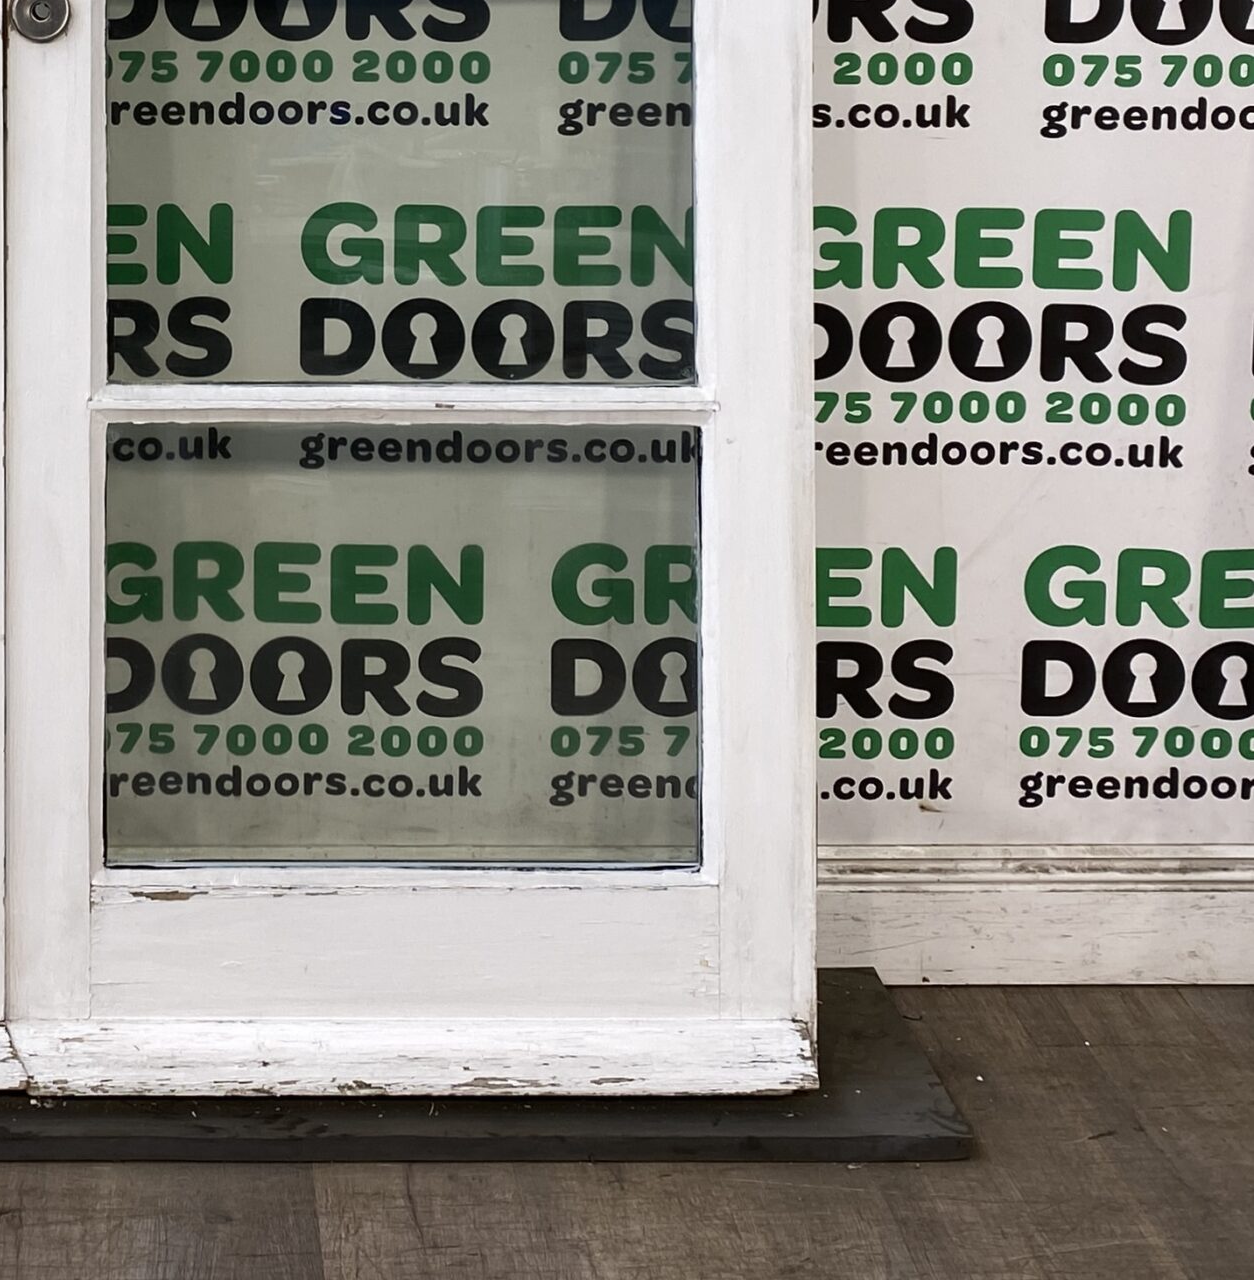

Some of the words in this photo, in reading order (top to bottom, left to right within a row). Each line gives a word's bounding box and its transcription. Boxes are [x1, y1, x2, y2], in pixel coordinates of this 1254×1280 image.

[108, 51, 178, 83] 75
[197, 50, 333, 82] 7000
[353, 50, 490, 84] 2000
[559, 52, 655, 84] 075
[833, 53, 973, 85] 2000
[1043, 54, 1141, 87] 075
[301, 204, 693, 287] GREEN
[891, 391, 1026, 423] 7000
[1046, 392, 1186, 426] 2000
[107, 723, 175, 754] 75
[194, 724, 328, 756] 7000
[348, 725, 483, 757] 2000
[551, 726, 644, 757] 075
[819, 728, 954, 759] 2000
[1020, 726, 1114, 758] 075
